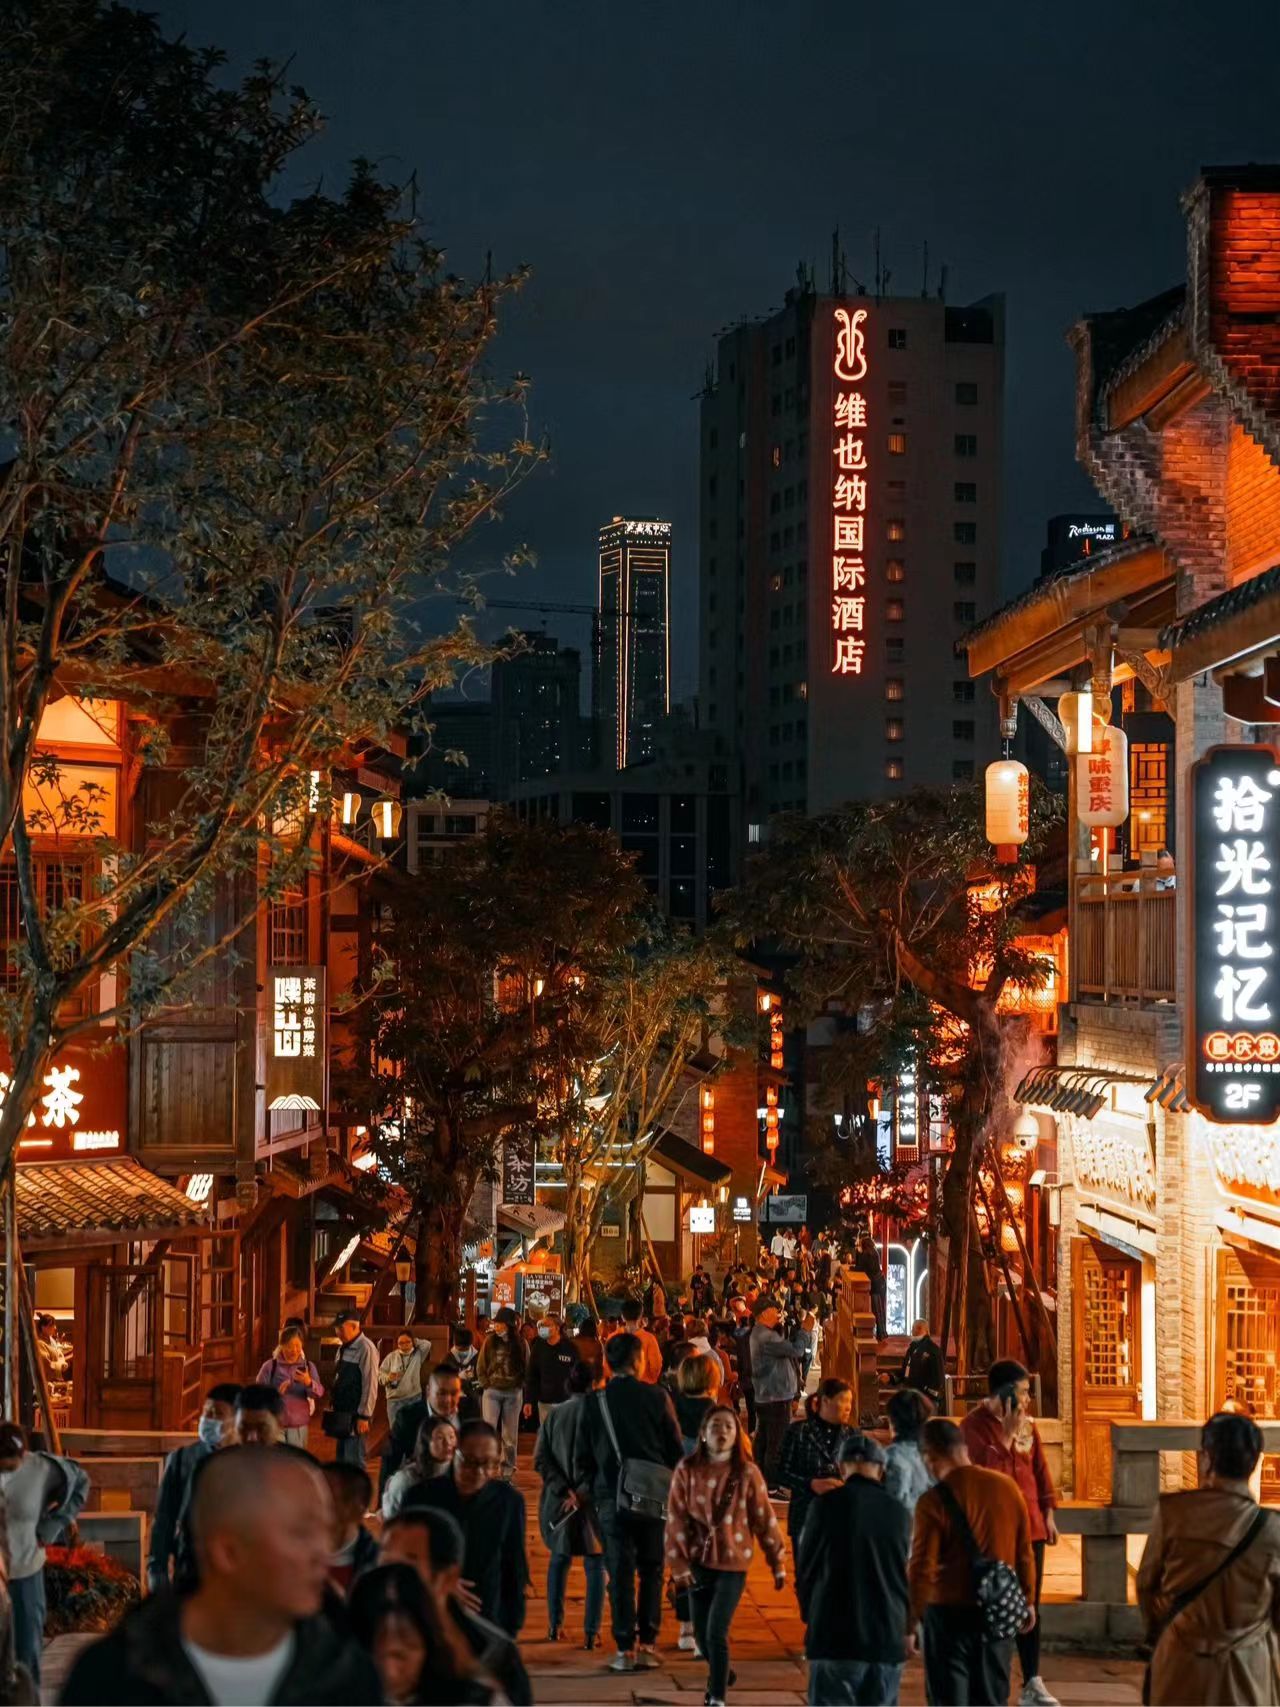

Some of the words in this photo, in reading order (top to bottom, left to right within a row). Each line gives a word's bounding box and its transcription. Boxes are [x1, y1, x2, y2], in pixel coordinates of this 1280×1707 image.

[832, 391, 868, 675] 维也纳国际酒店
[1213, 775, 1273, 1022] 拾光记忆
[1210, 1036, 1278, 1057] 重庆菜
[1225, 1083, 1262, 1109] 2F
